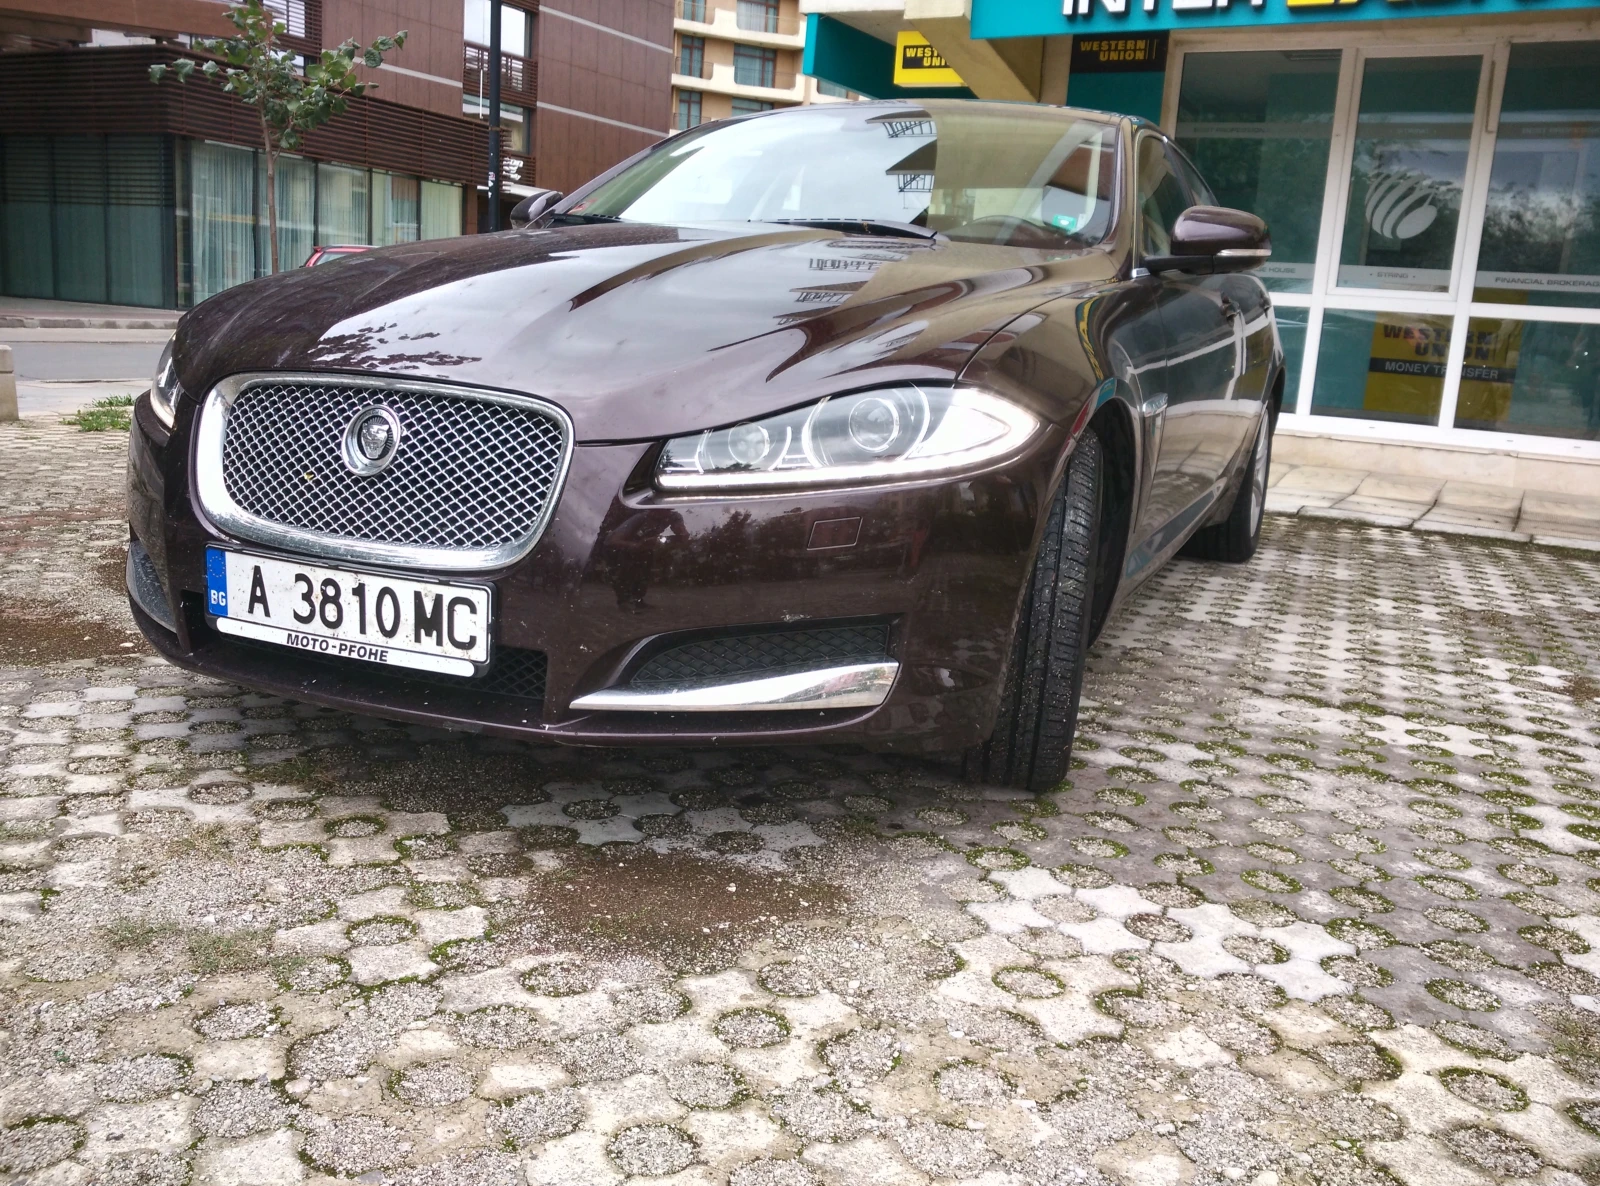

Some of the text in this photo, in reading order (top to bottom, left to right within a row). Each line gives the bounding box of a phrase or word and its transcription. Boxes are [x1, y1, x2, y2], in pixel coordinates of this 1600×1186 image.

[1080, 40, 1146, 51] WESTERN
[905, 47, 938, 57] WEST
[1099, 50, 1145, 61] UNION
[923, 56, 948, 66] UNI
[1377, 271, 1409, 279] STRING
[1495, 276, 1544, 285] FINANCIAL
[1385, 361, 1429, 373] MONEY
[210, 589, 226, 607] BG
[247, 564, 478, 650] A 3810 MC
